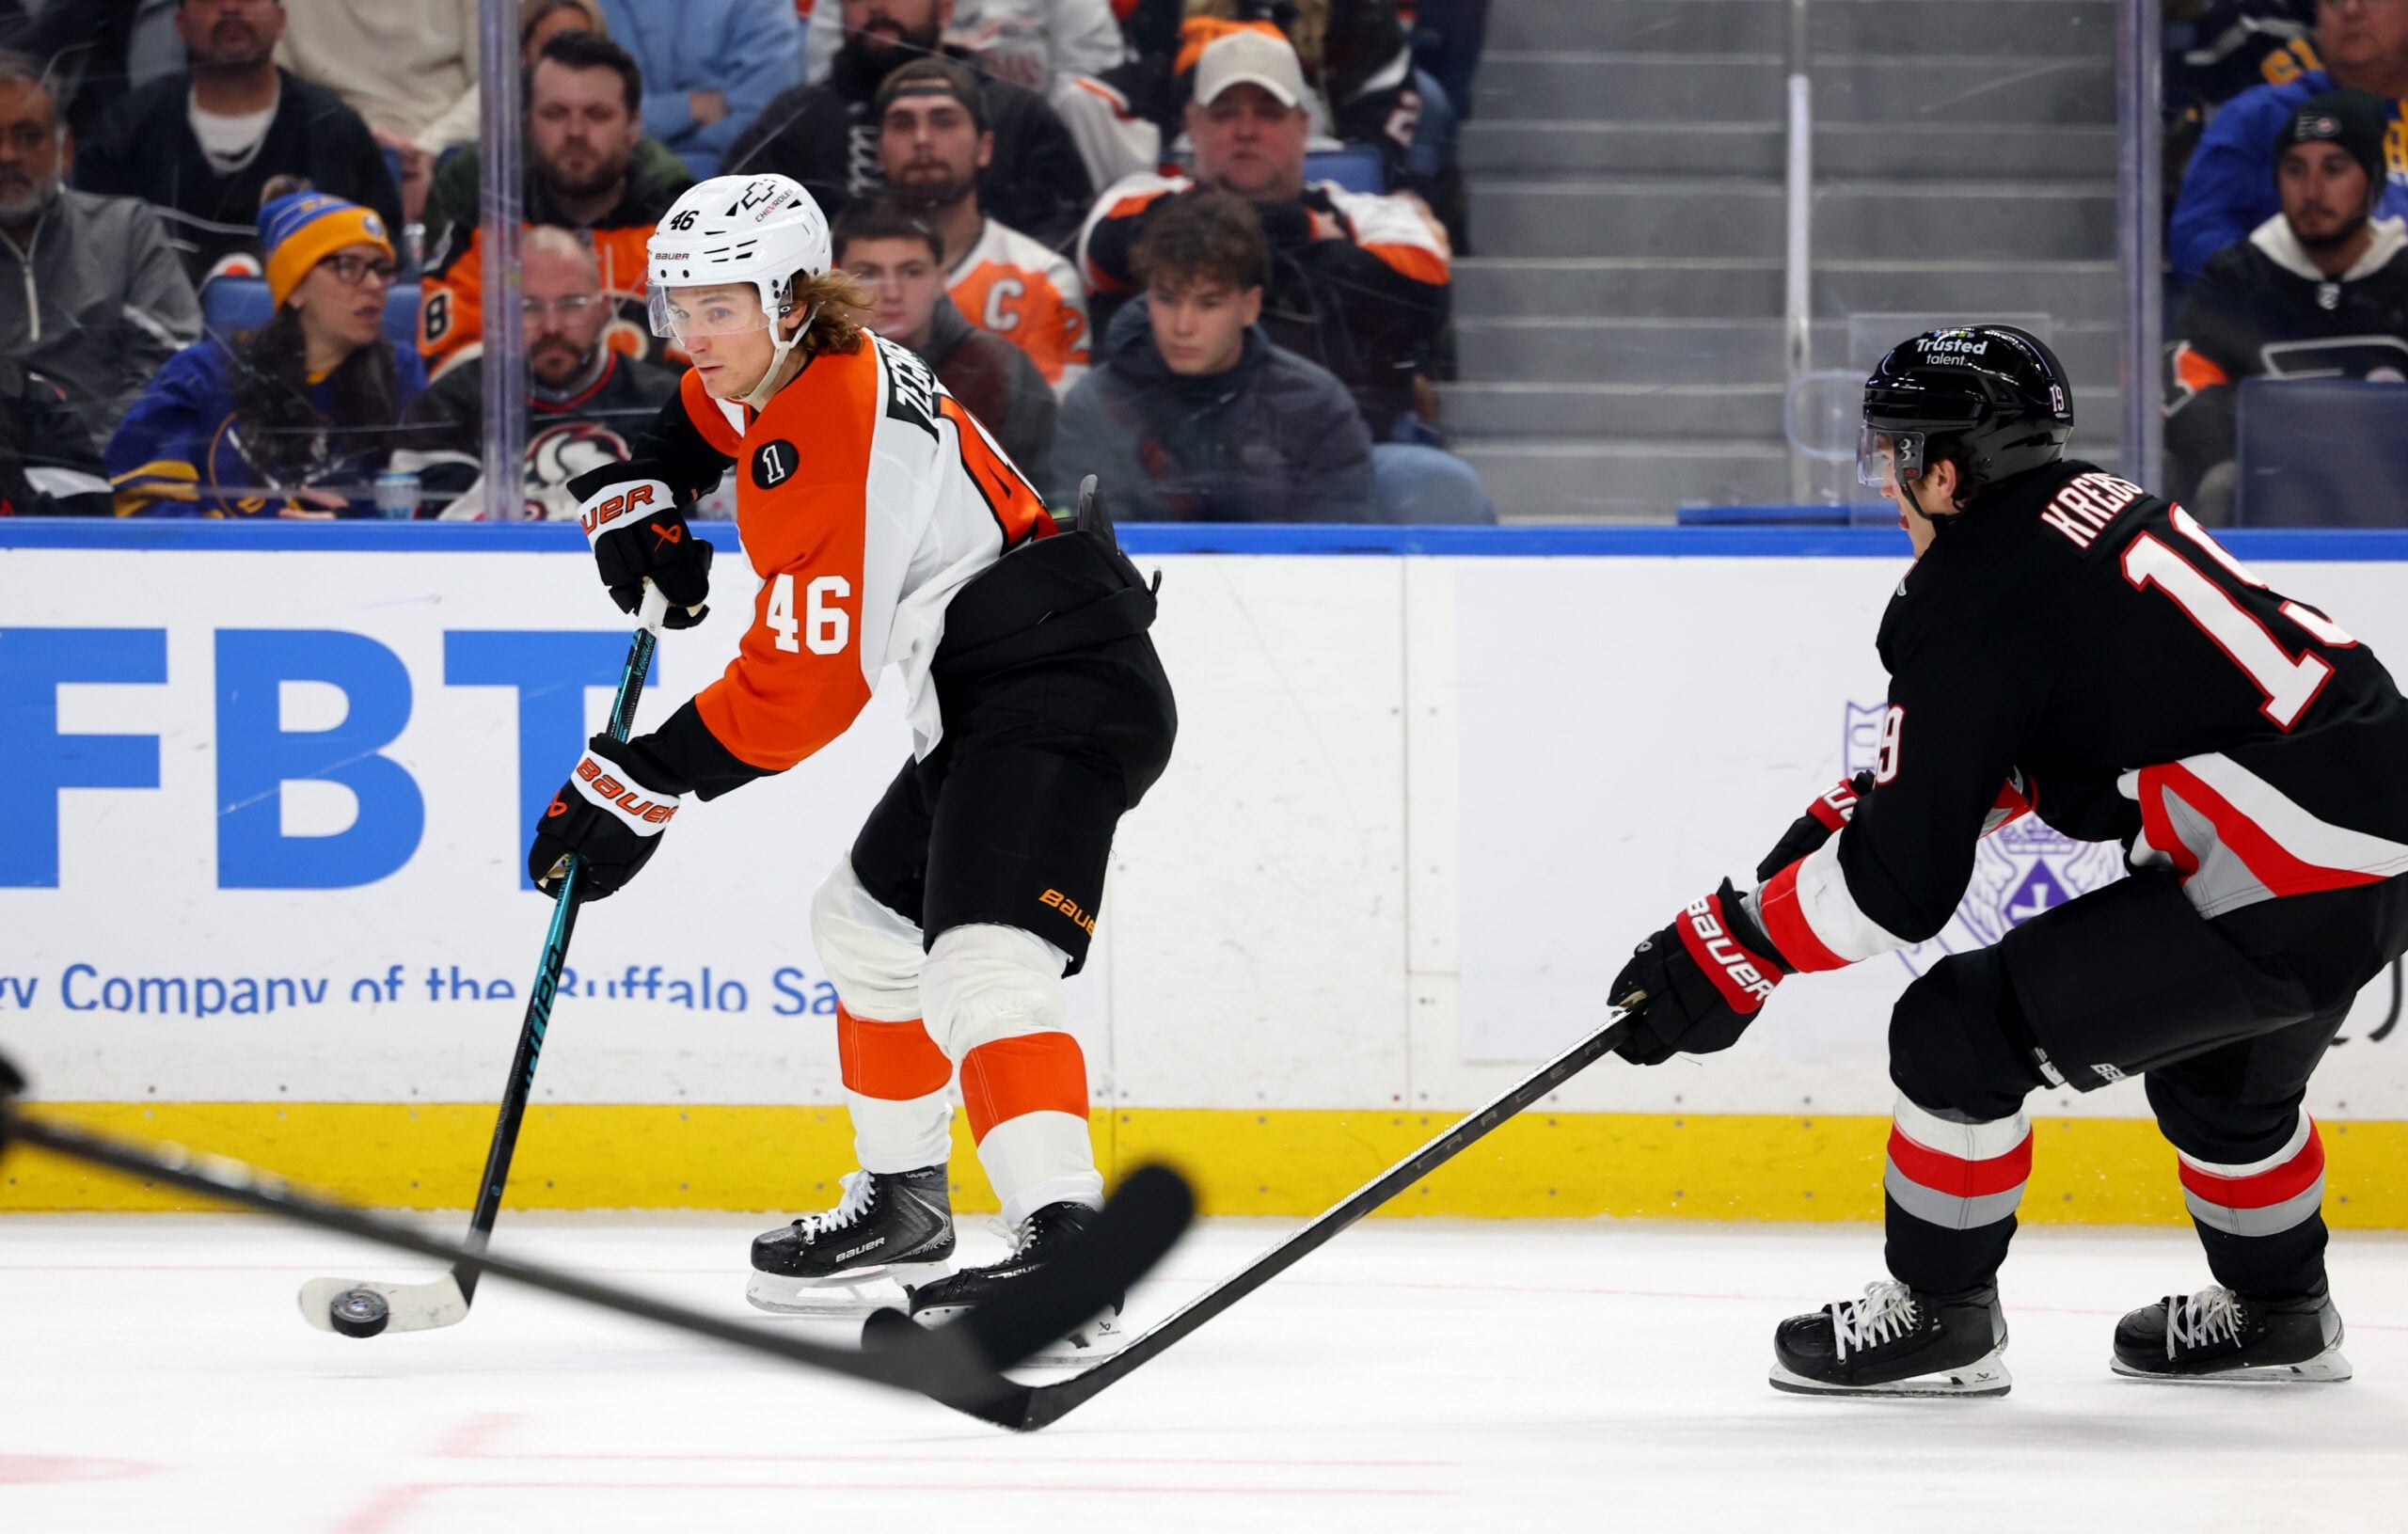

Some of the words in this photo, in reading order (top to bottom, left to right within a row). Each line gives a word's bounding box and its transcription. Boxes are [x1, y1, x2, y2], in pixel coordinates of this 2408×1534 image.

[669, 210, 700, 231] 46
[655, 252, 689, 261] BAUER
[1916, 339, 1988, 356] Trusted
[2050, 385, 2066, 412] 19
[762, 444, 785, 484] 1
[580, 483, 656, 536] UER
[2039, 472, 2144, 550] KREBS
[767, 573, 850, 656] 46
[0, 627, 658, 892] FBT
[1038, 888, 1096, 937] BAUE
[1686, 896, 1777, 1003] BAUER
[835, 1237, 886, 1264] BAUER
